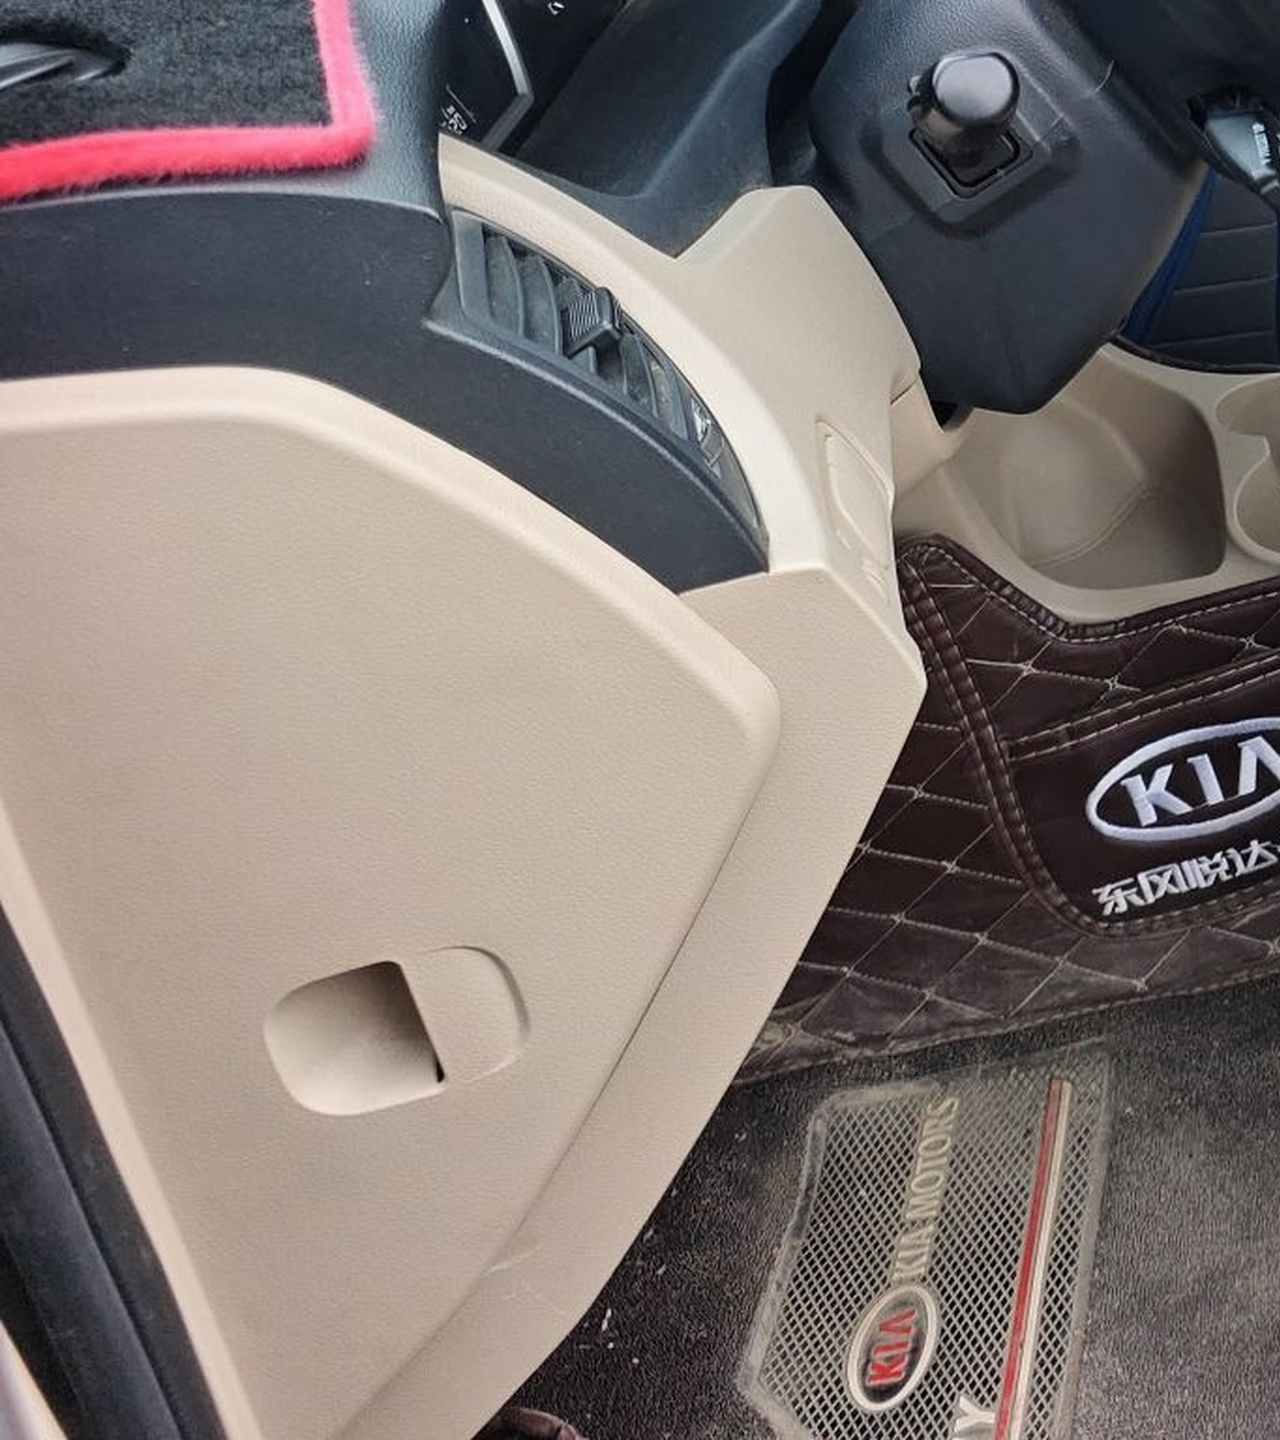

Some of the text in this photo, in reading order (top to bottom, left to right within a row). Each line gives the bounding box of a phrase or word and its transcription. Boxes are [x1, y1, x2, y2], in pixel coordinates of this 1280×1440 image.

[895, 1096, 960, 1282] KIA MOTORS
[868, 1307, 919, 1387] KIA
